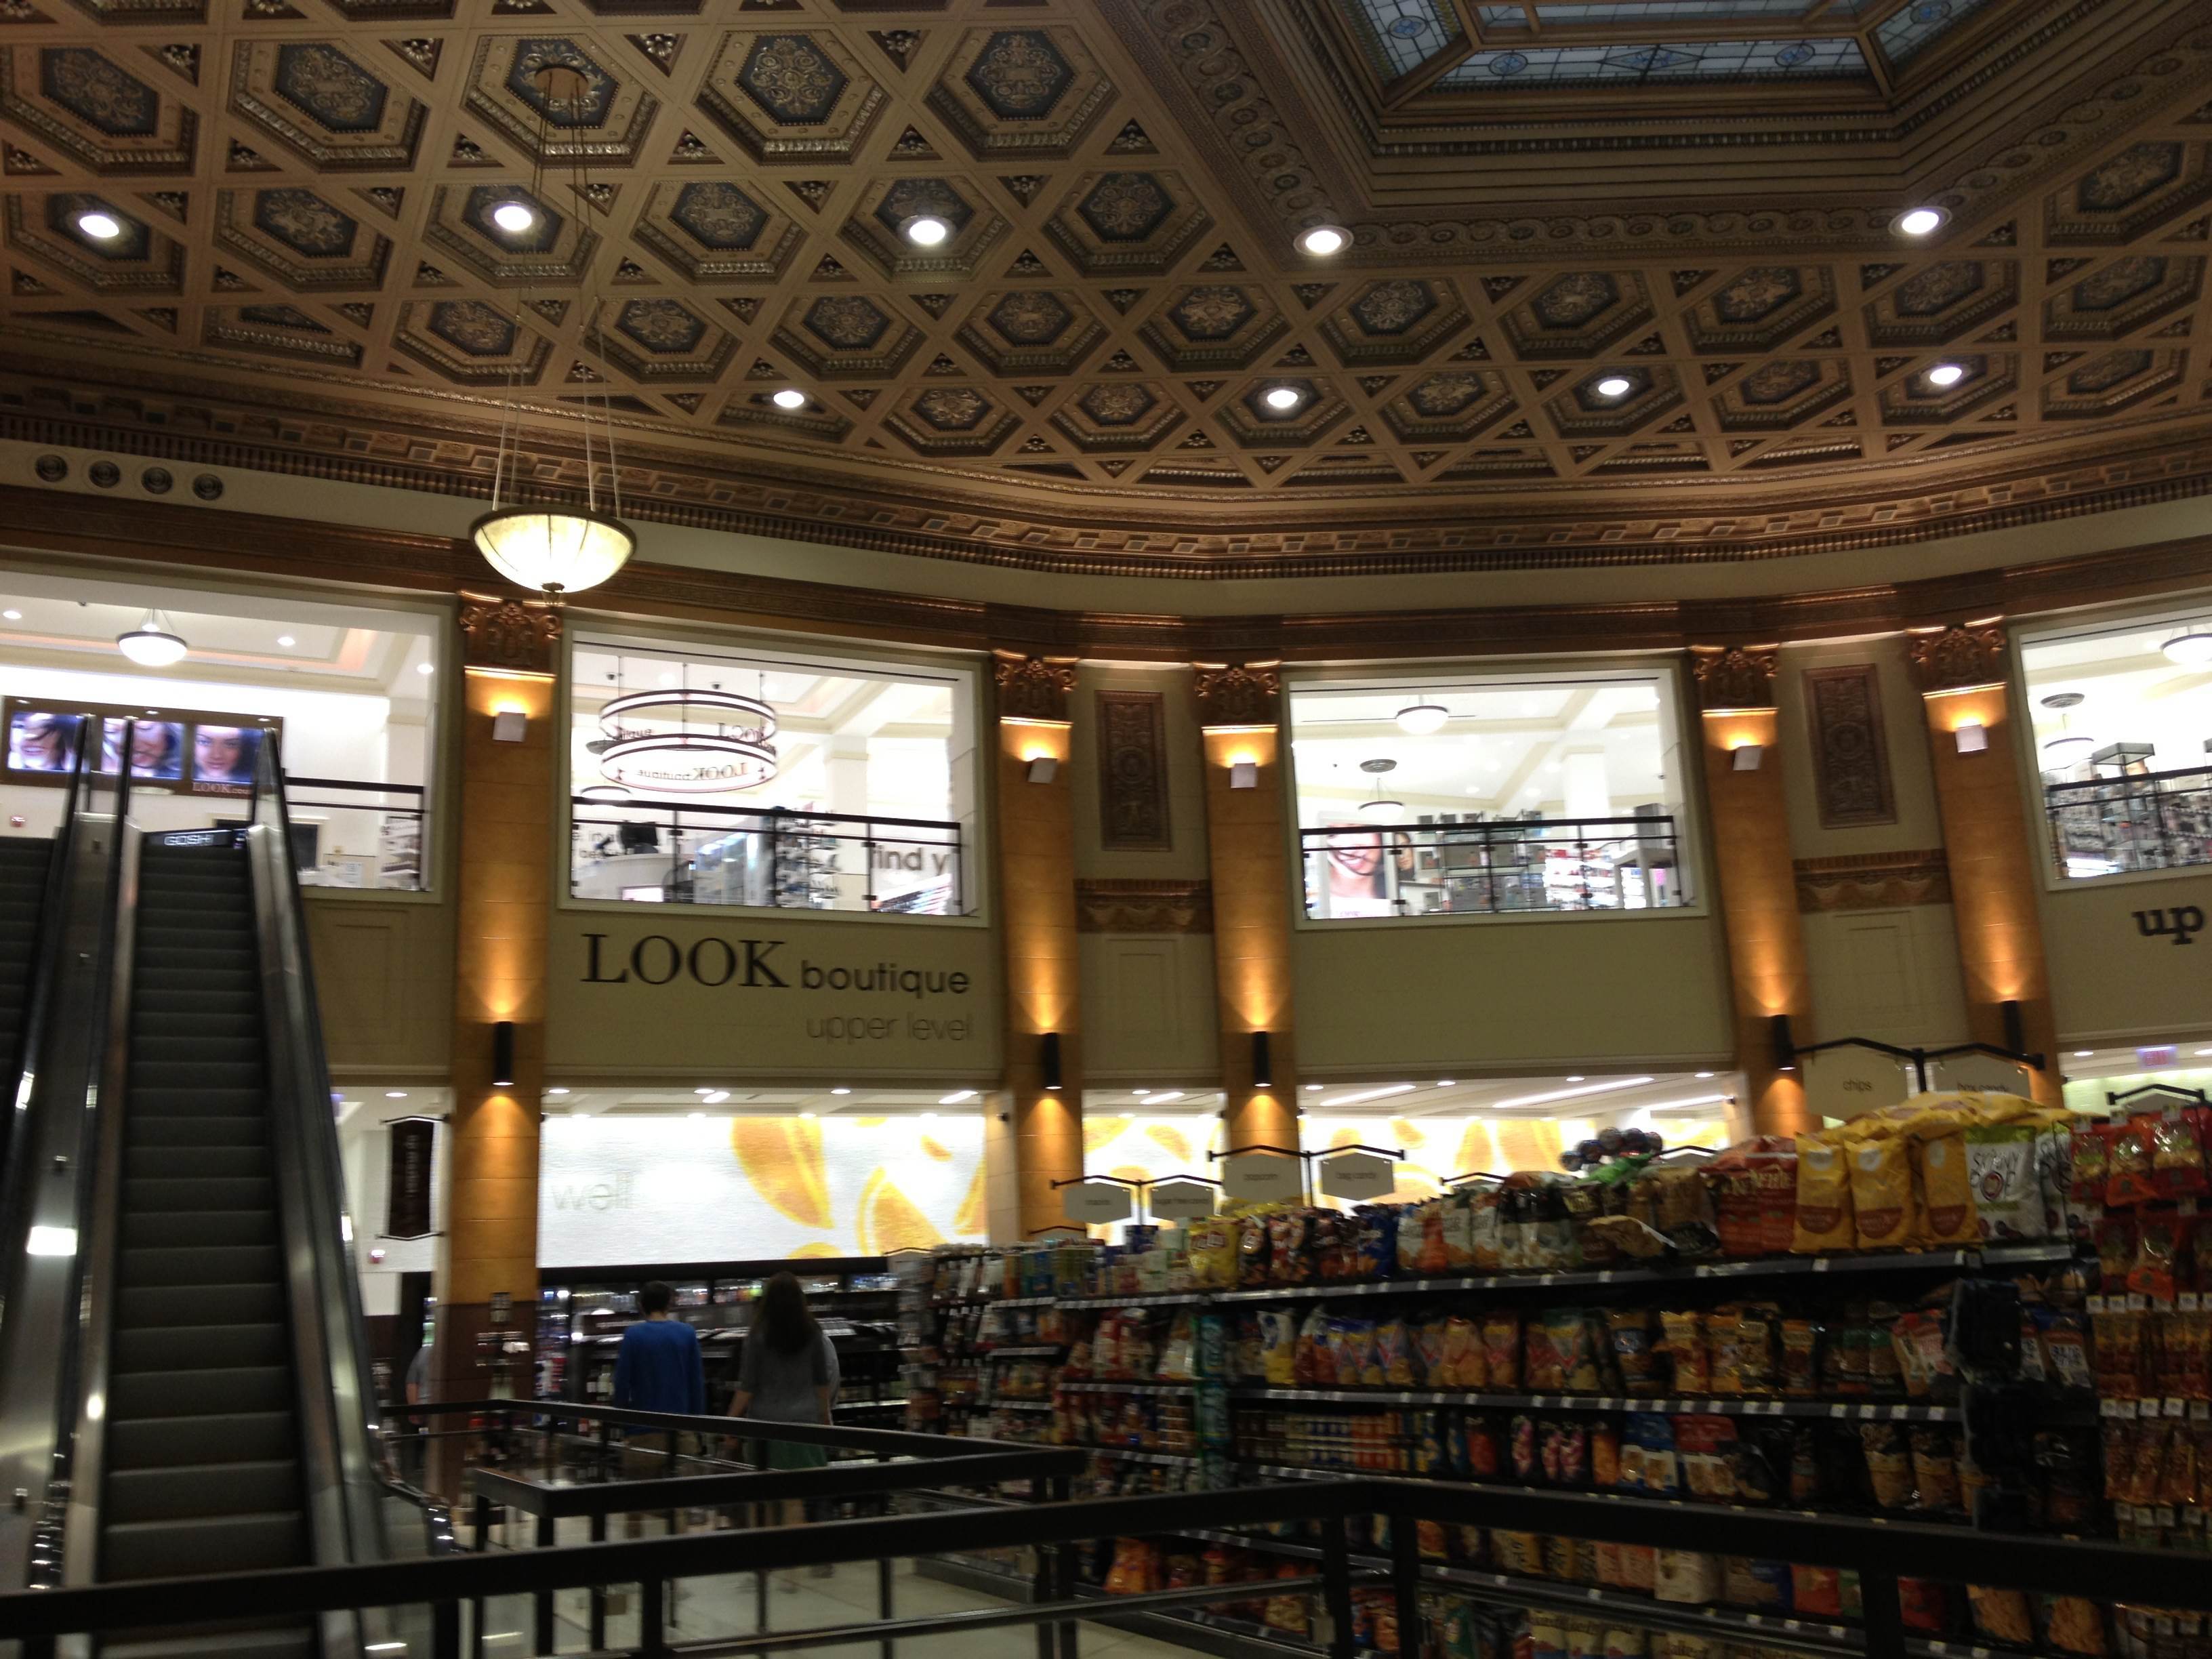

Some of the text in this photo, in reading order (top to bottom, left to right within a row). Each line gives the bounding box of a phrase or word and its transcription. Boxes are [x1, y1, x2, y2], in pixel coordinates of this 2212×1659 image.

[2131, 905, 2205, 945] up
[579, 933, 970, 1000] LOOK boutique
[806, 1012, 974, 1045] upper level
[1843, 1079, 1872, 1093] chips
